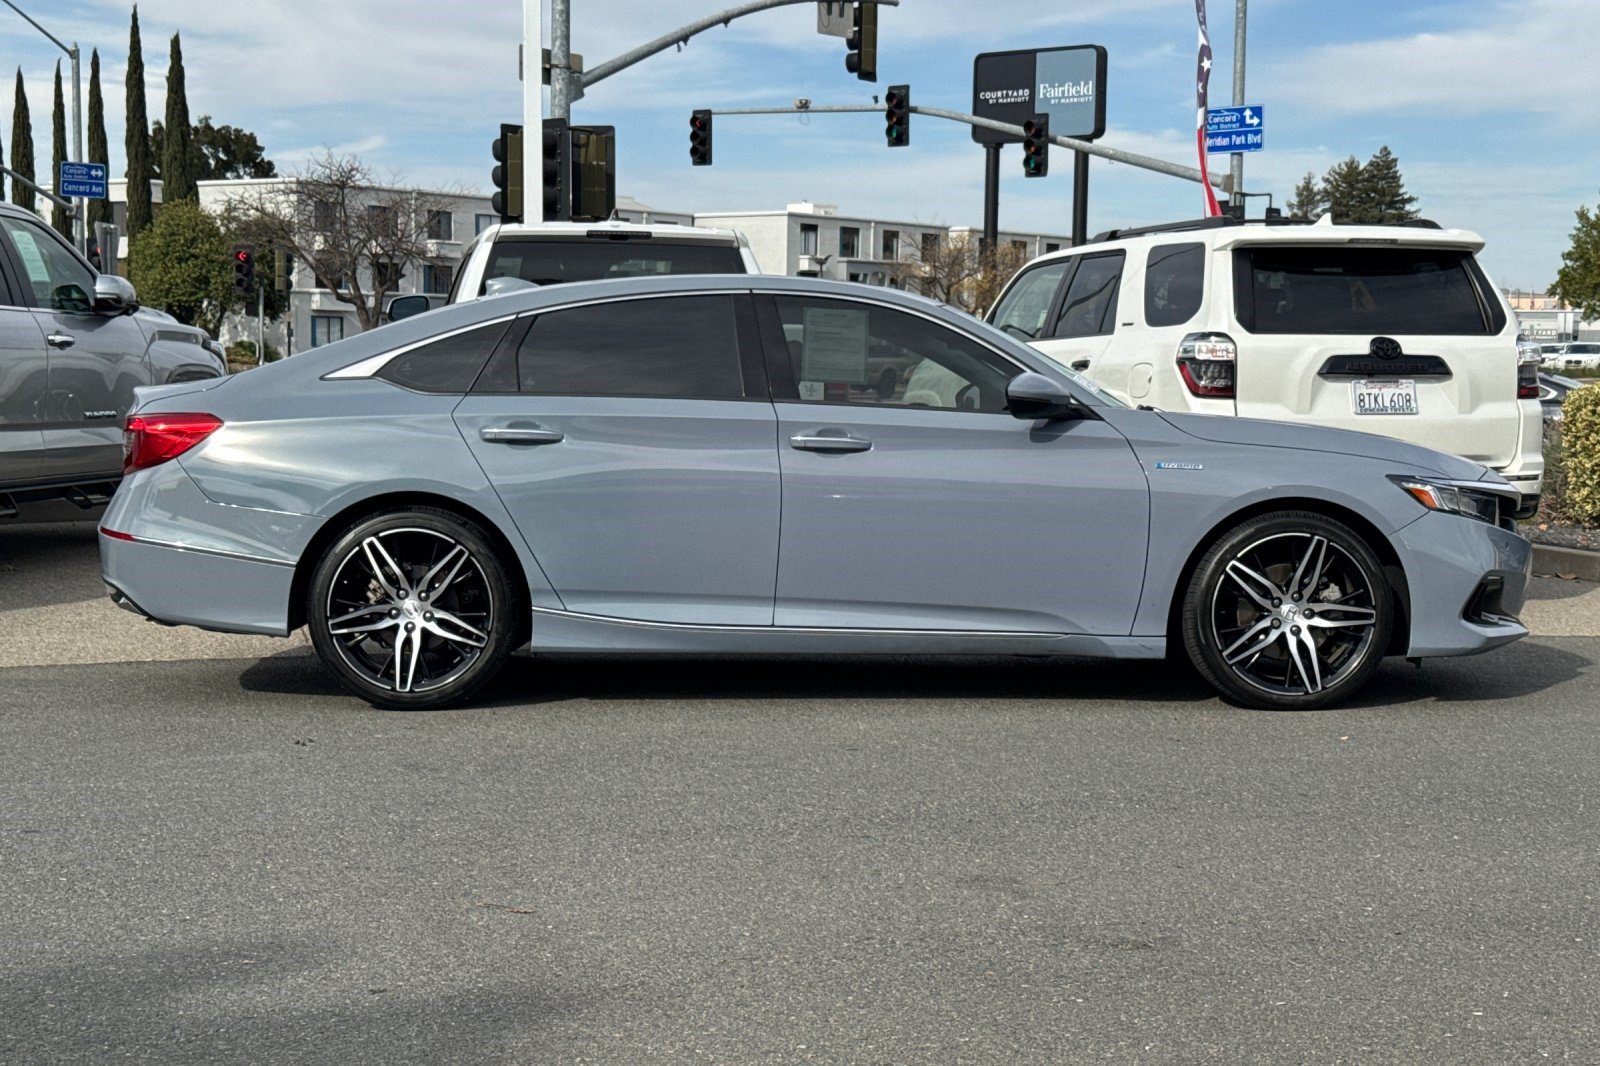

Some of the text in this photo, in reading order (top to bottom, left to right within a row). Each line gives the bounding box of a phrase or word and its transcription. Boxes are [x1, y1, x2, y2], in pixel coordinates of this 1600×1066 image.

[979, 88, 1030, 100] COURTYARD
[1039, 80, 1093, 99] Fairfield
[998, 96, 1029, 104] MARRIOTT
[1060, 96, 1093, 104] MARRIOTT
[1208, 115, 1237, 124] Concord
[1231, 134, 1246, 145] Park
[1247, 133, 1262, 144] Blvd
[63, 182, 103, 194] Concord Ave
[1358, 392, 1412, 409] 8TKL608
